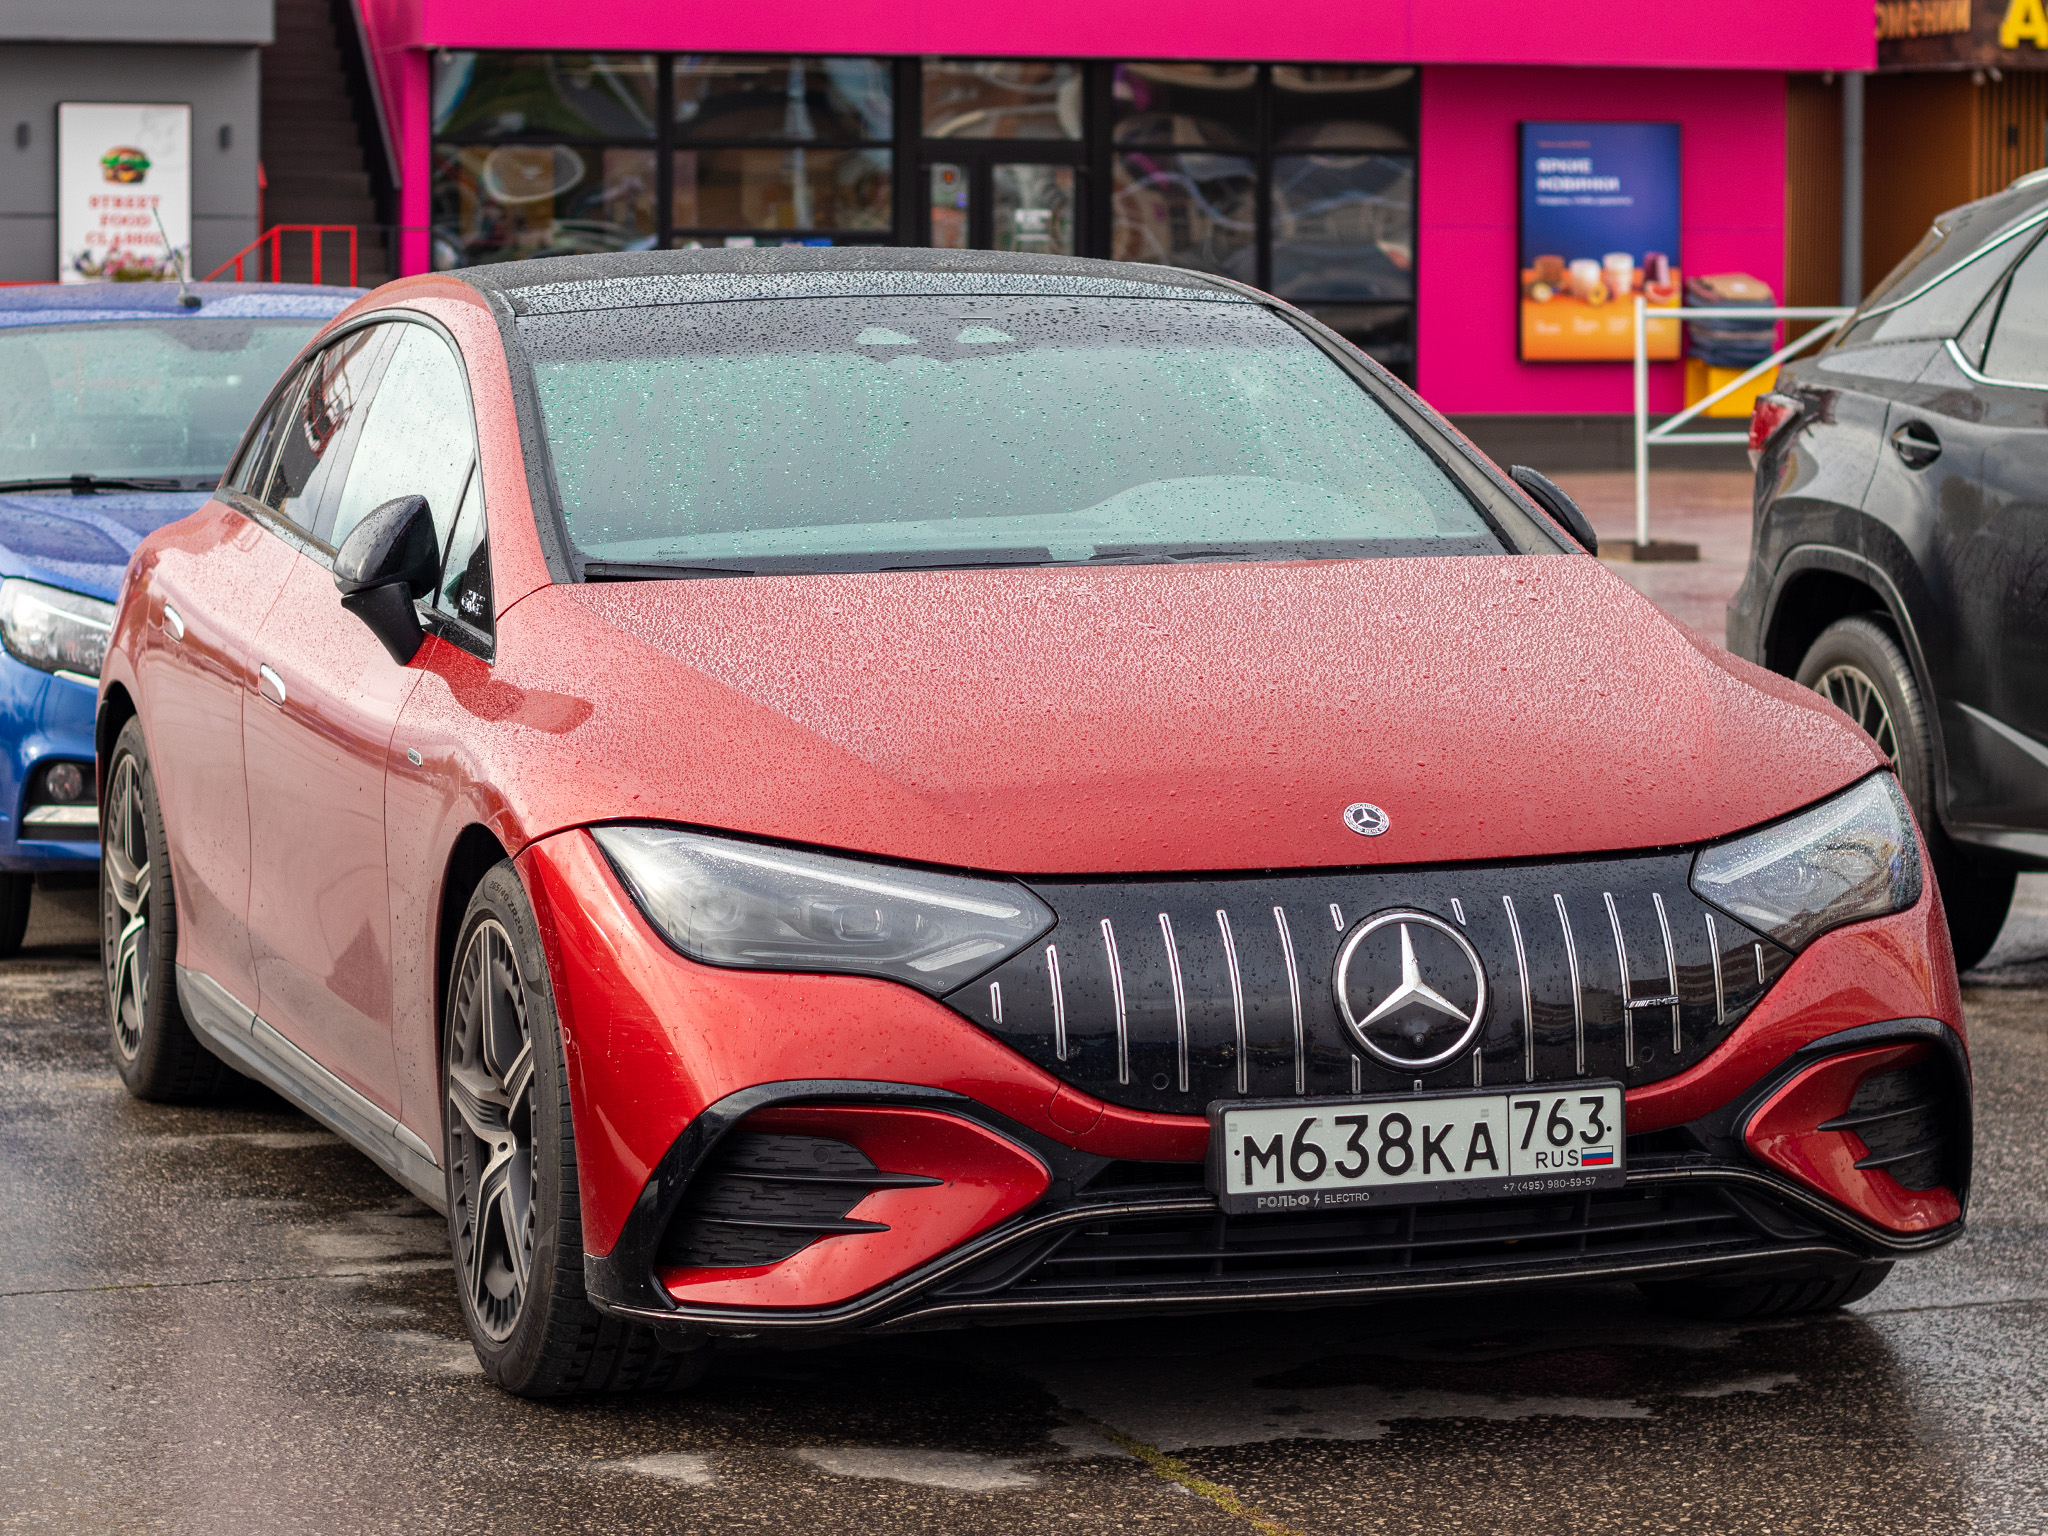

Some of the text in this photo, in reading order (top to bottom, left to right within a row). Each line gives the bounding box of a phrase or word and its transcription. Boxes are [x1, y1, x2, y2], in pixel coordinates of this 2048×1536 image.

[1537, 176, 1620, 192] НОВИНКИ
[89, 195, 160, 208] STREET
[101, 214, 151, 227] FOOD
[1514, 1096, 1605, 1150] 763
[1535, 1150, 1579, 1169] RUS
[1503, 1176, 1597, 1191] +7 (495) 980-59-57
[1257, 1194, 1310, 1209] РОЛЬФ
[1324, 1192, 1370, 1204] ELECTRO
